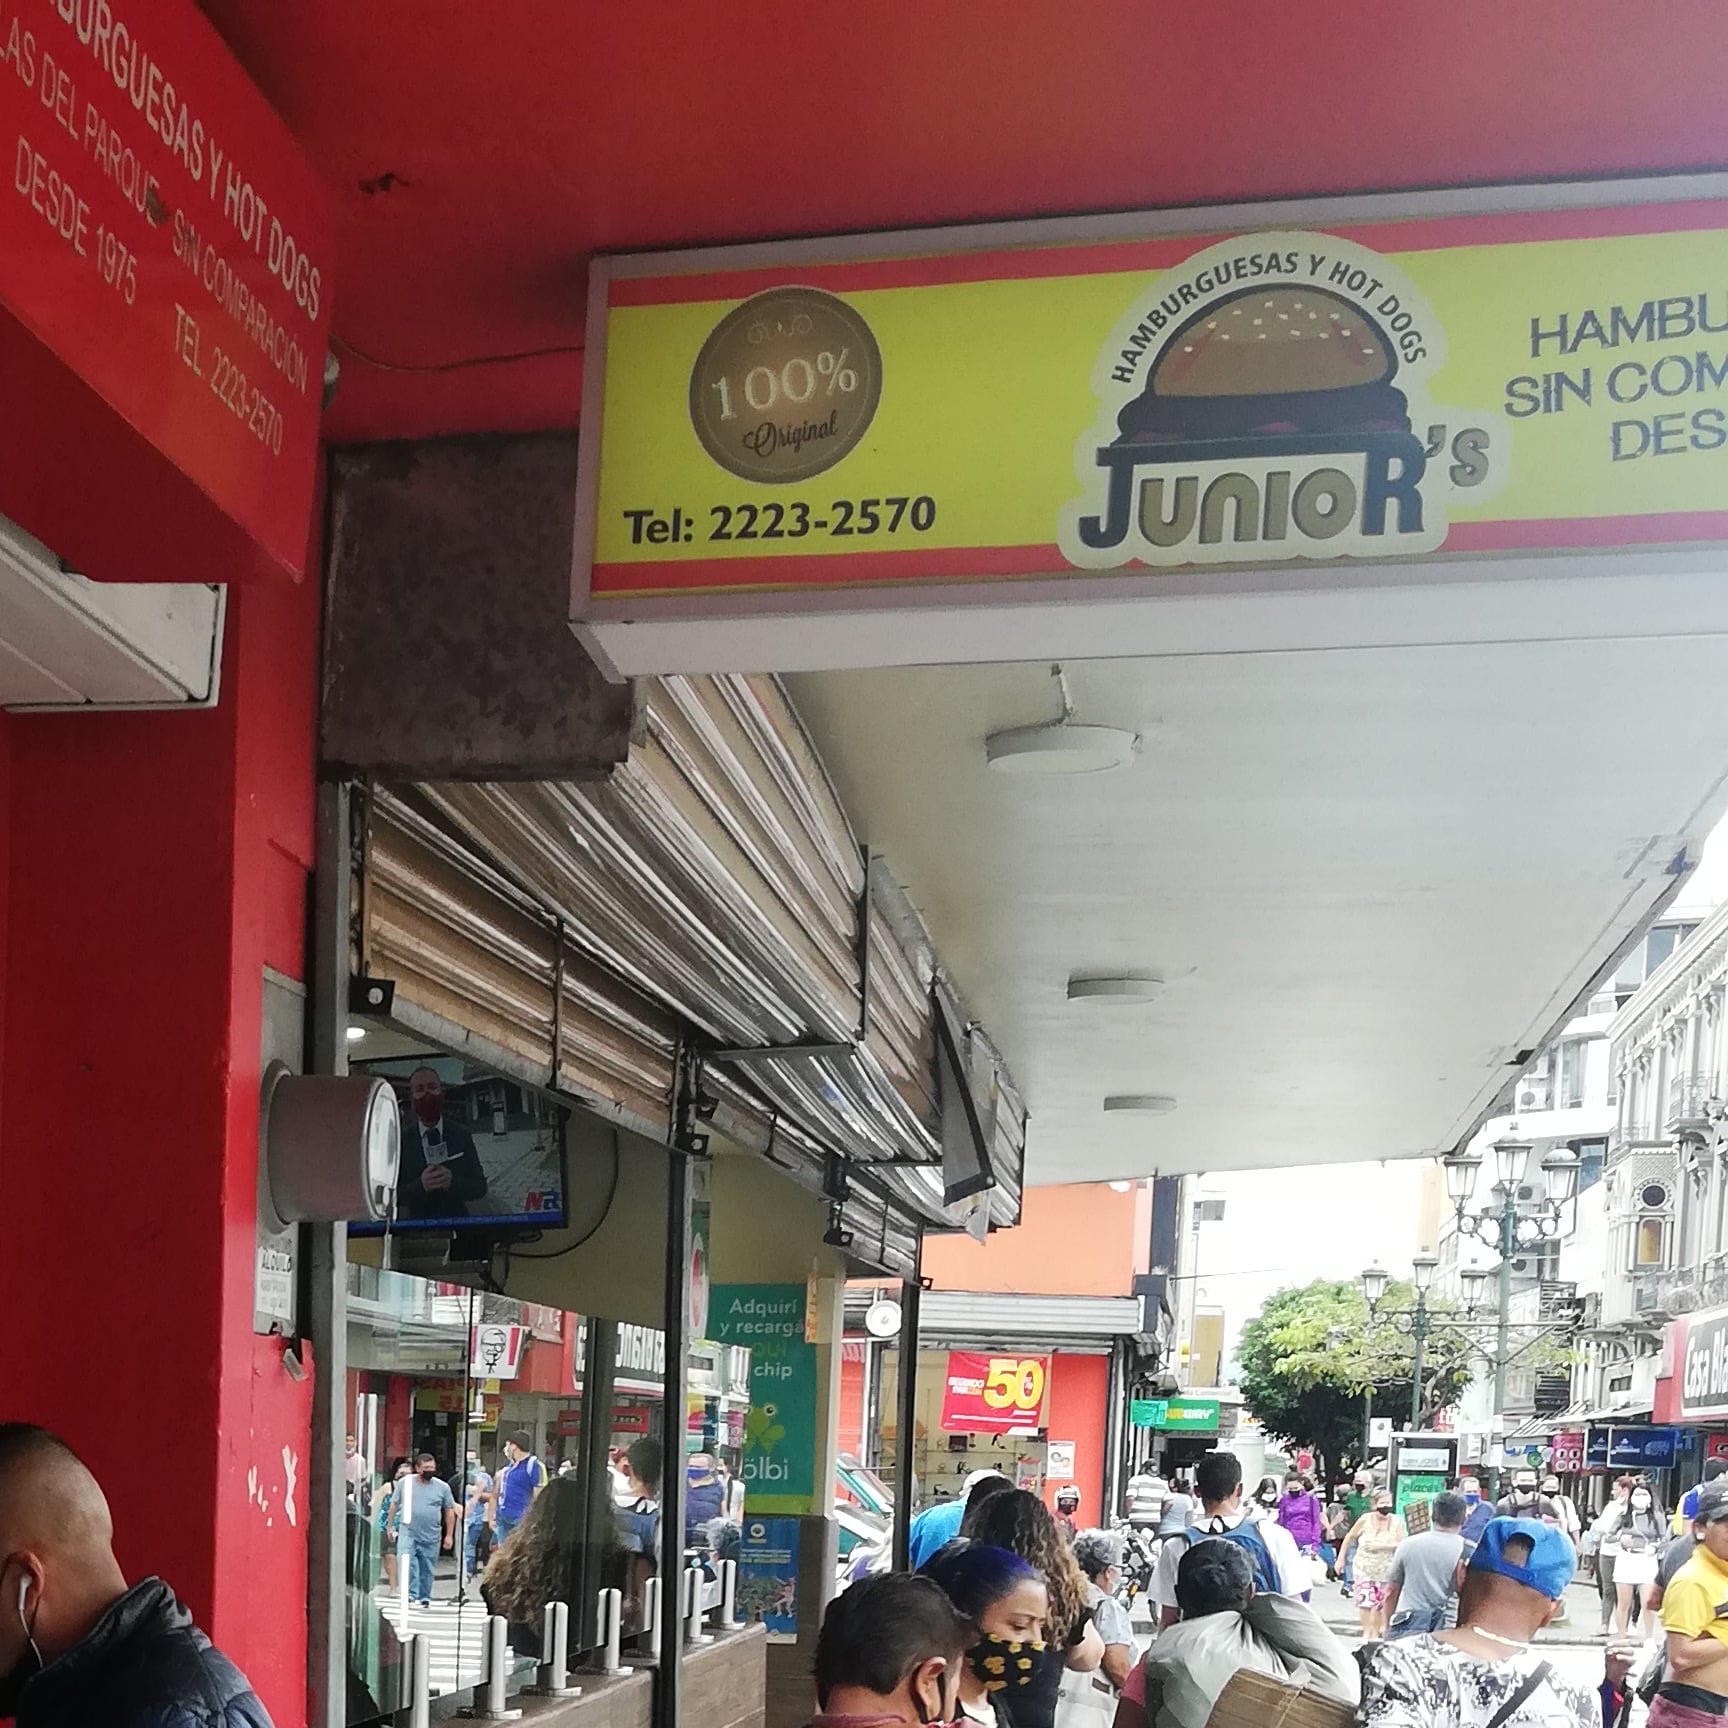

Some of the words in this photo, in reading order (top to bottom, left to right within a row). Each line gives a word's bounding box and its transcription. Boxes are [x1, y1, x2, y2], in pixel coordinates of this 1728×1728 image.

[41, 52, 79, 140] DEL
[173, 208, 201, 276] SIN
[209, 137, 223, 201] Y
[224, 161, 267, 255] HOT
[268, 216, 321, 321] DOGS
[15, 135, 90, 257] DESDE
[96, 225, 137, 305] 1975
[210, 346, 283, 457] 2223-2570
[1111, 251, 1299, 386] HAMBURGUESAS
[1308, 252, 1327, 278] Y
[1329, 259, 1383, 300] HOT
[1383, 294, 1428, 366] DOGS
[712, 346, 859, 423] 100%
[1504, 367, 1592, 418] SIN
[742, 410, 839, 458] Original
[1610, 408, 1728, 462] DES
[623, 507, 694, 546] Tel:
[708, 496, 937, 543] 2223-2570
[720, 1321, 730, 1337] y
[743, 1457, 789, 1481] ölbi
